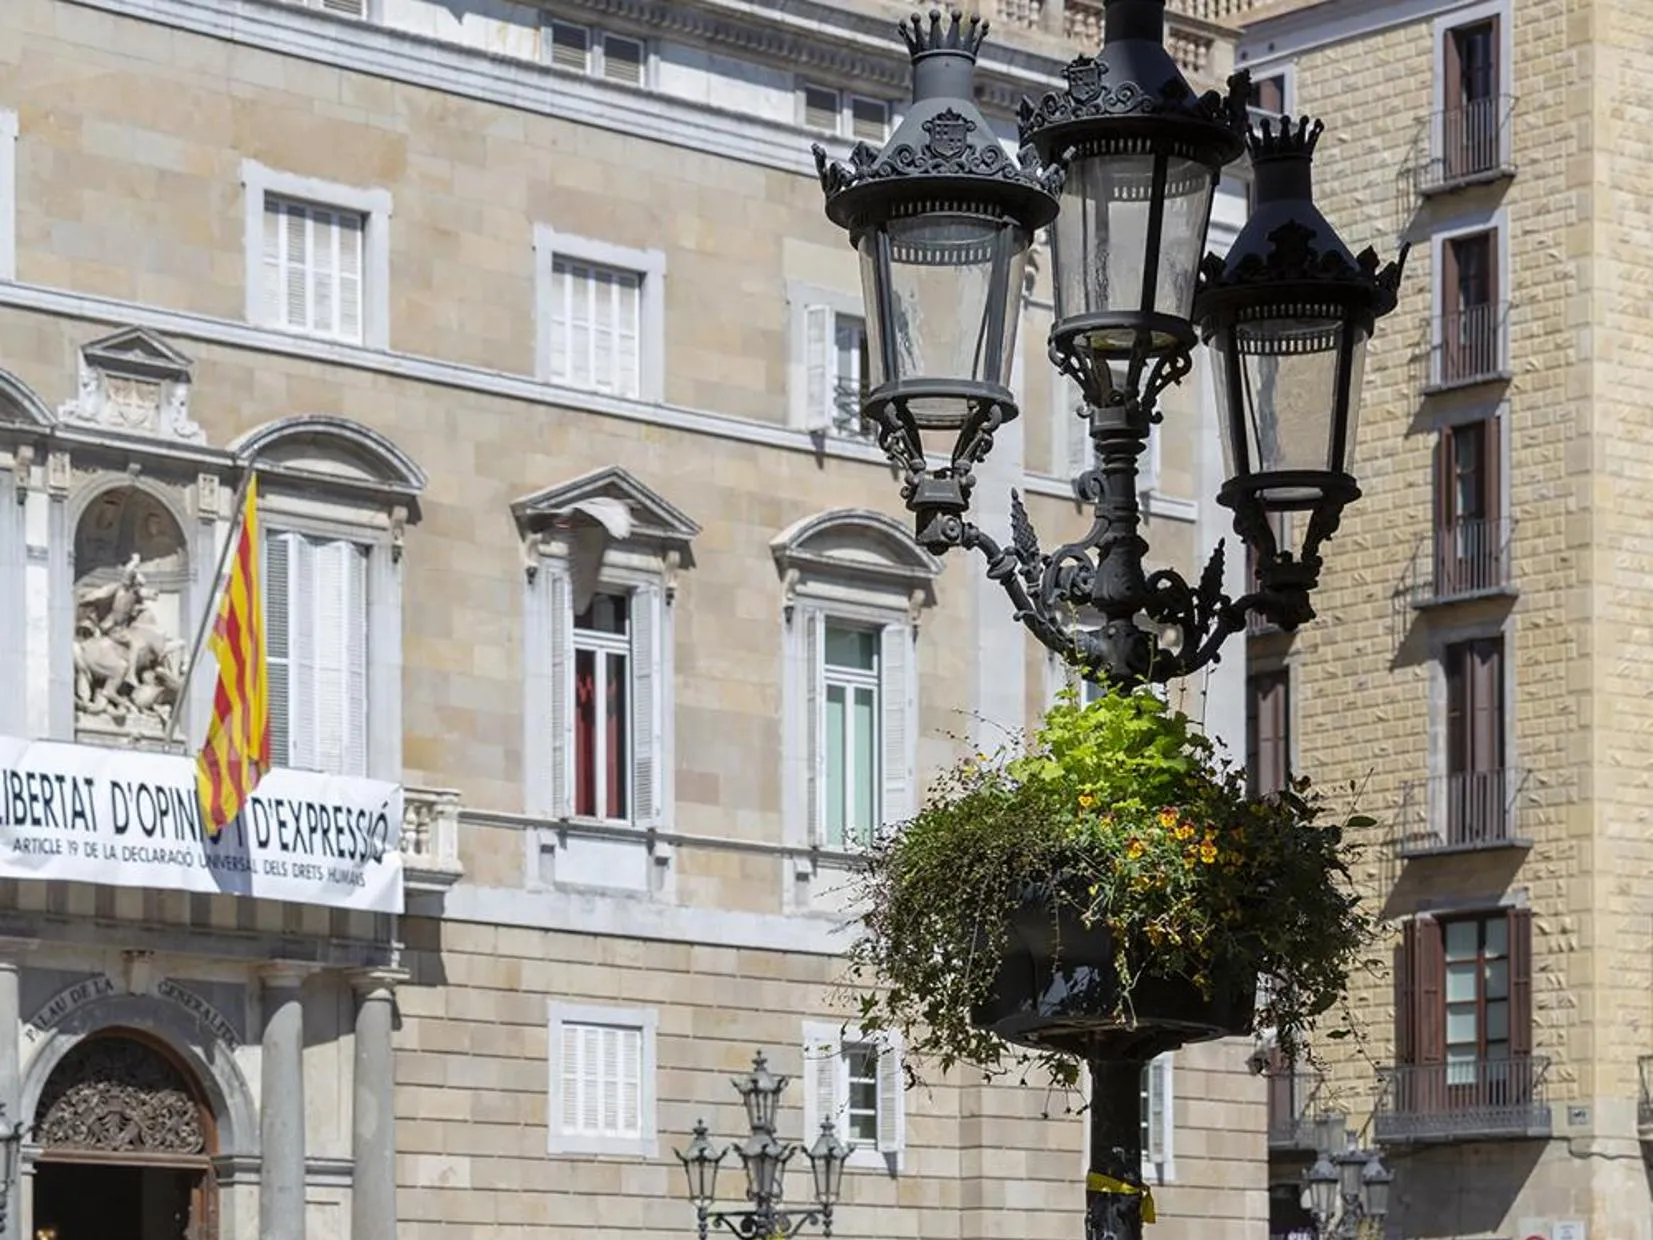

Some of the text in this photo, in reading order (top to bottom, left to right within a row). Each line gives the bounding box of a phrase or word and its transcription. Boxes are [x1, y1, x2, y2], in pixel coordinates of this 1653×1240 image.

[0, 769, 97, 832] IBERTAT
[110, 779, 221, 845] D'OPINI
[251, 797, 389, 864] D'EXPRESSIÓ
[12, 837, 366, 887] ARTICLE 19 DE LA DECLARACIÓ UNIVERSAL DELS DRETS HUMANS
[70, 986, 92, 1005] DE
[93, 977, 114, 995] LA
